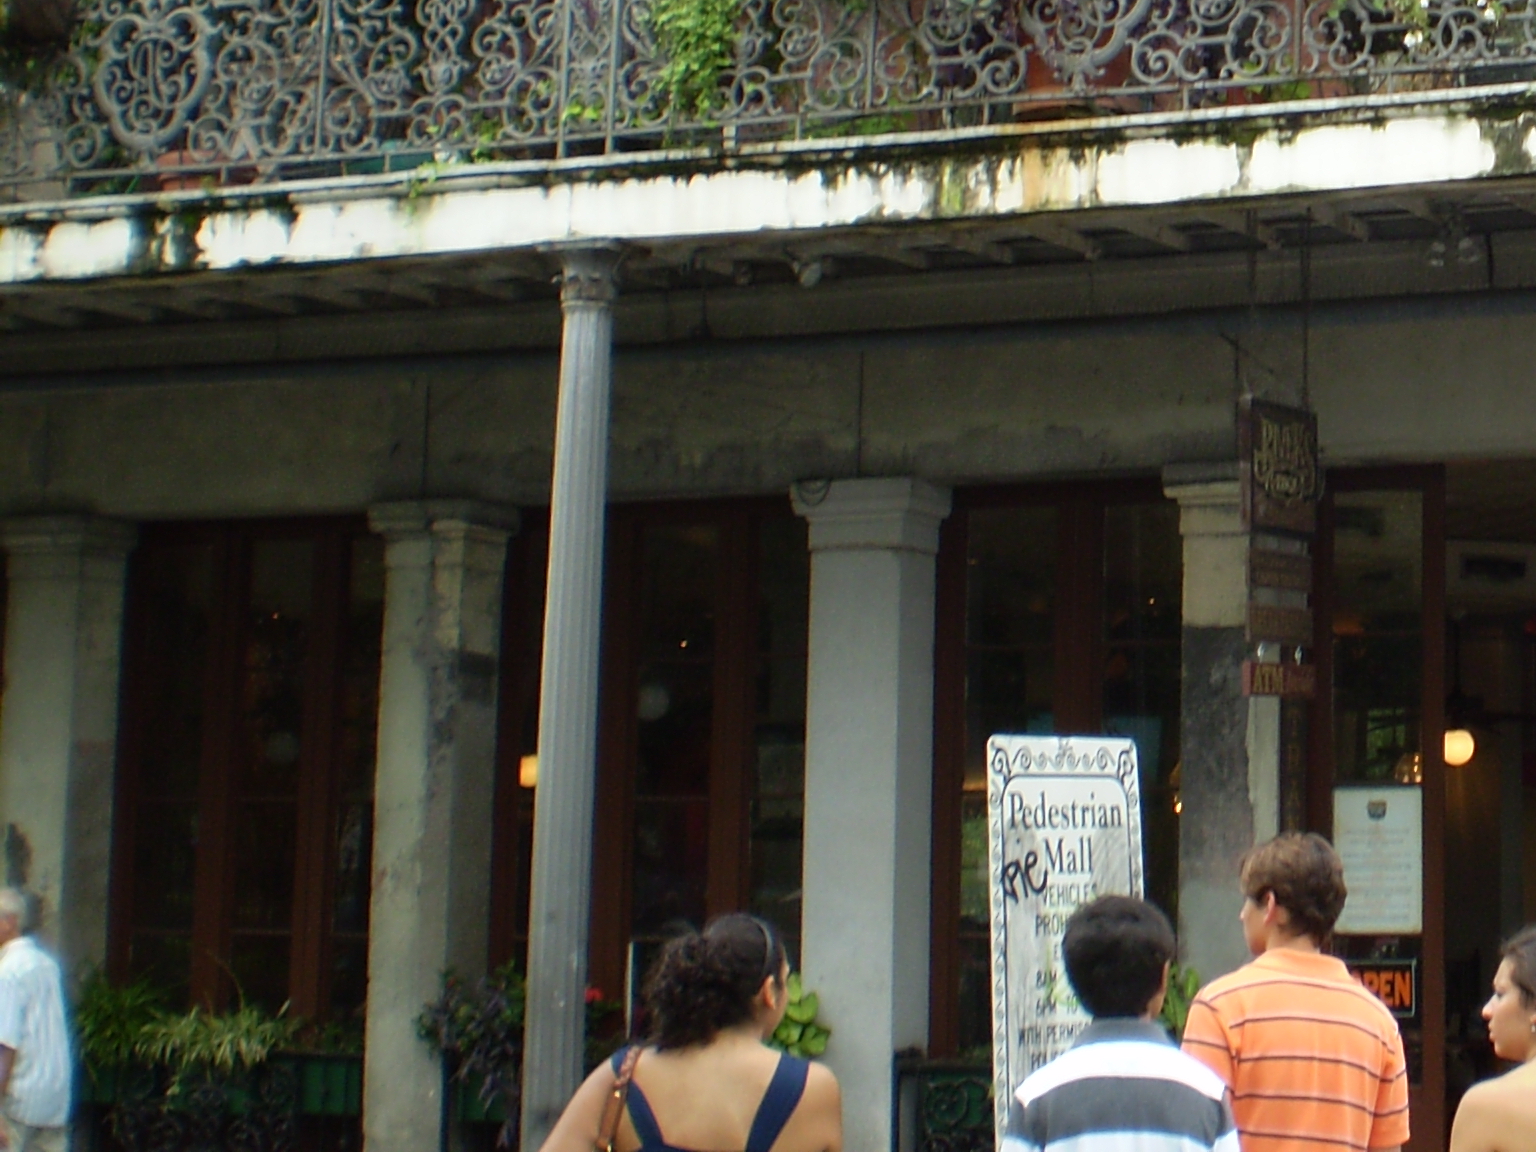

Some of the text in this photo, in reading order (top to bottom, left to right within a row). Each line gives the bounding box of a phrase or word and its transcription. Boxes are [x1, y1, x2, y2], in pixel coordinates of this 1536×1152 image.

[1253, 665, 1285, 695] ATM
[1008, 790, 1122, 830] Pedestrian
[1044, 834, 1093, 875] Mall
[1351, 969, 1411, 1008] PEN
